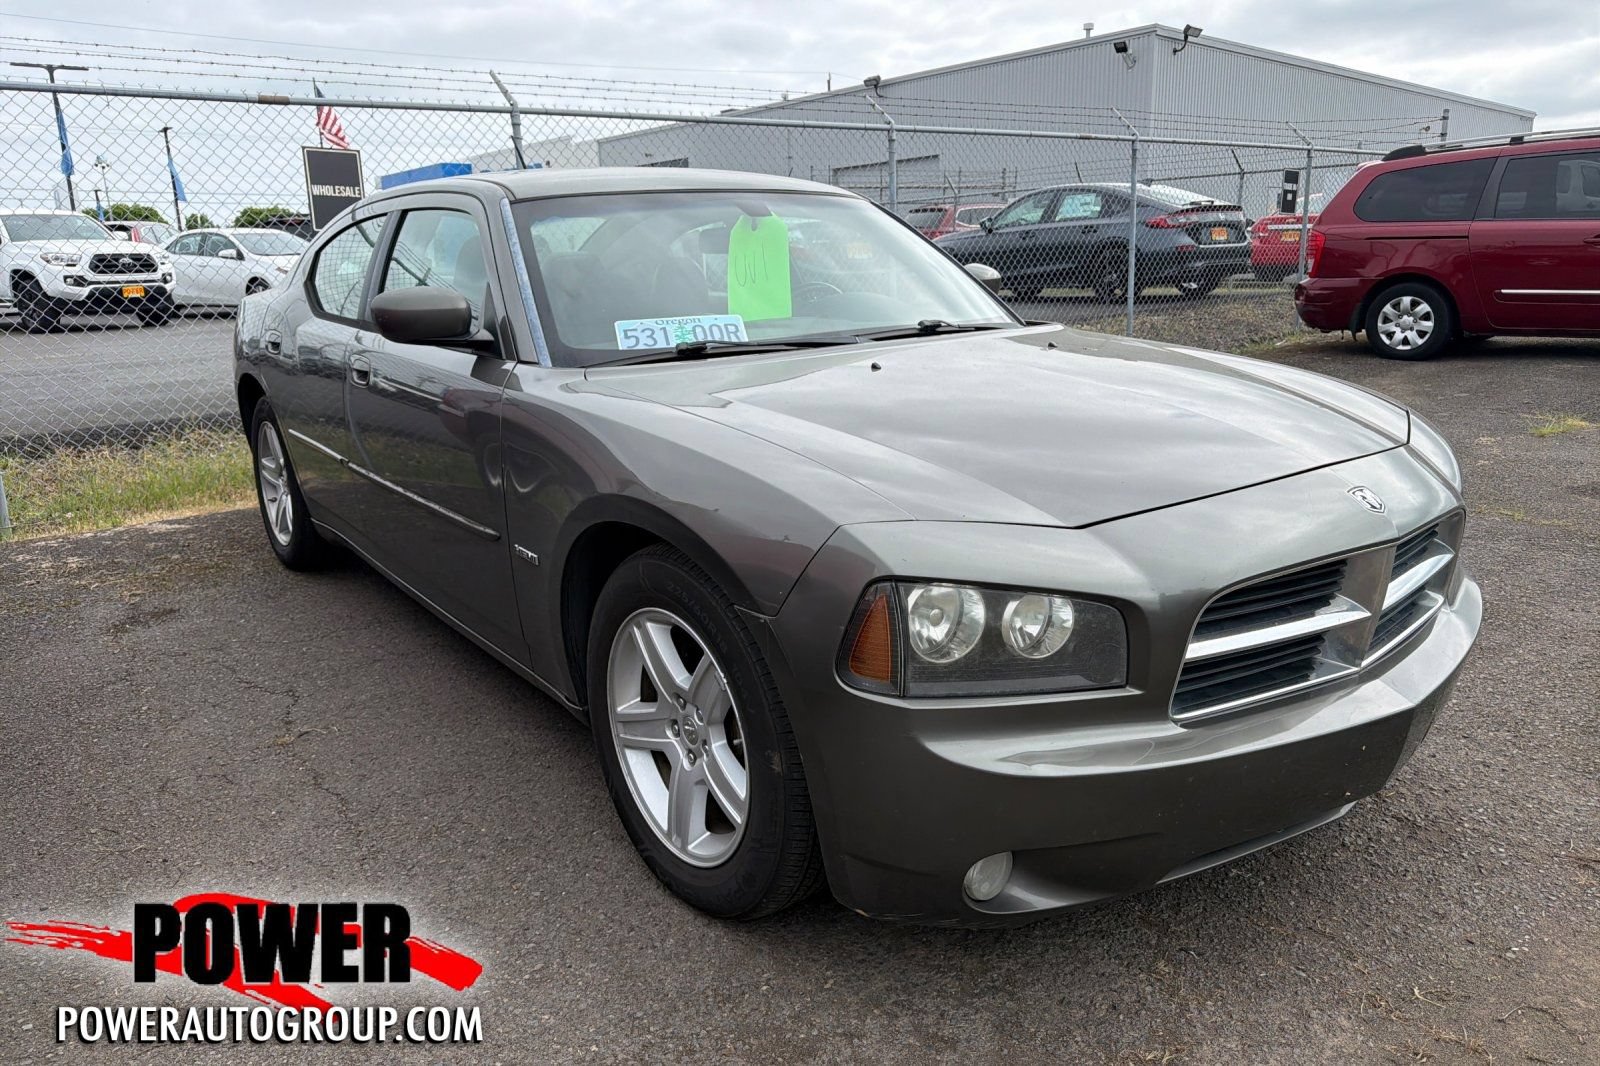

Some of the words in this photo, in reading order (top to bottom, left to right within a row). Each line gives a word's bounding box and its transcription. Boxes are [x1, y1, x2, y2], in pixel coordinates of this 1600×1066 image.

[311, 184, 361, 197] WHOLESALE
[655, 317, 702, 326] Oregon
[622, 327, 671, 349] 531
